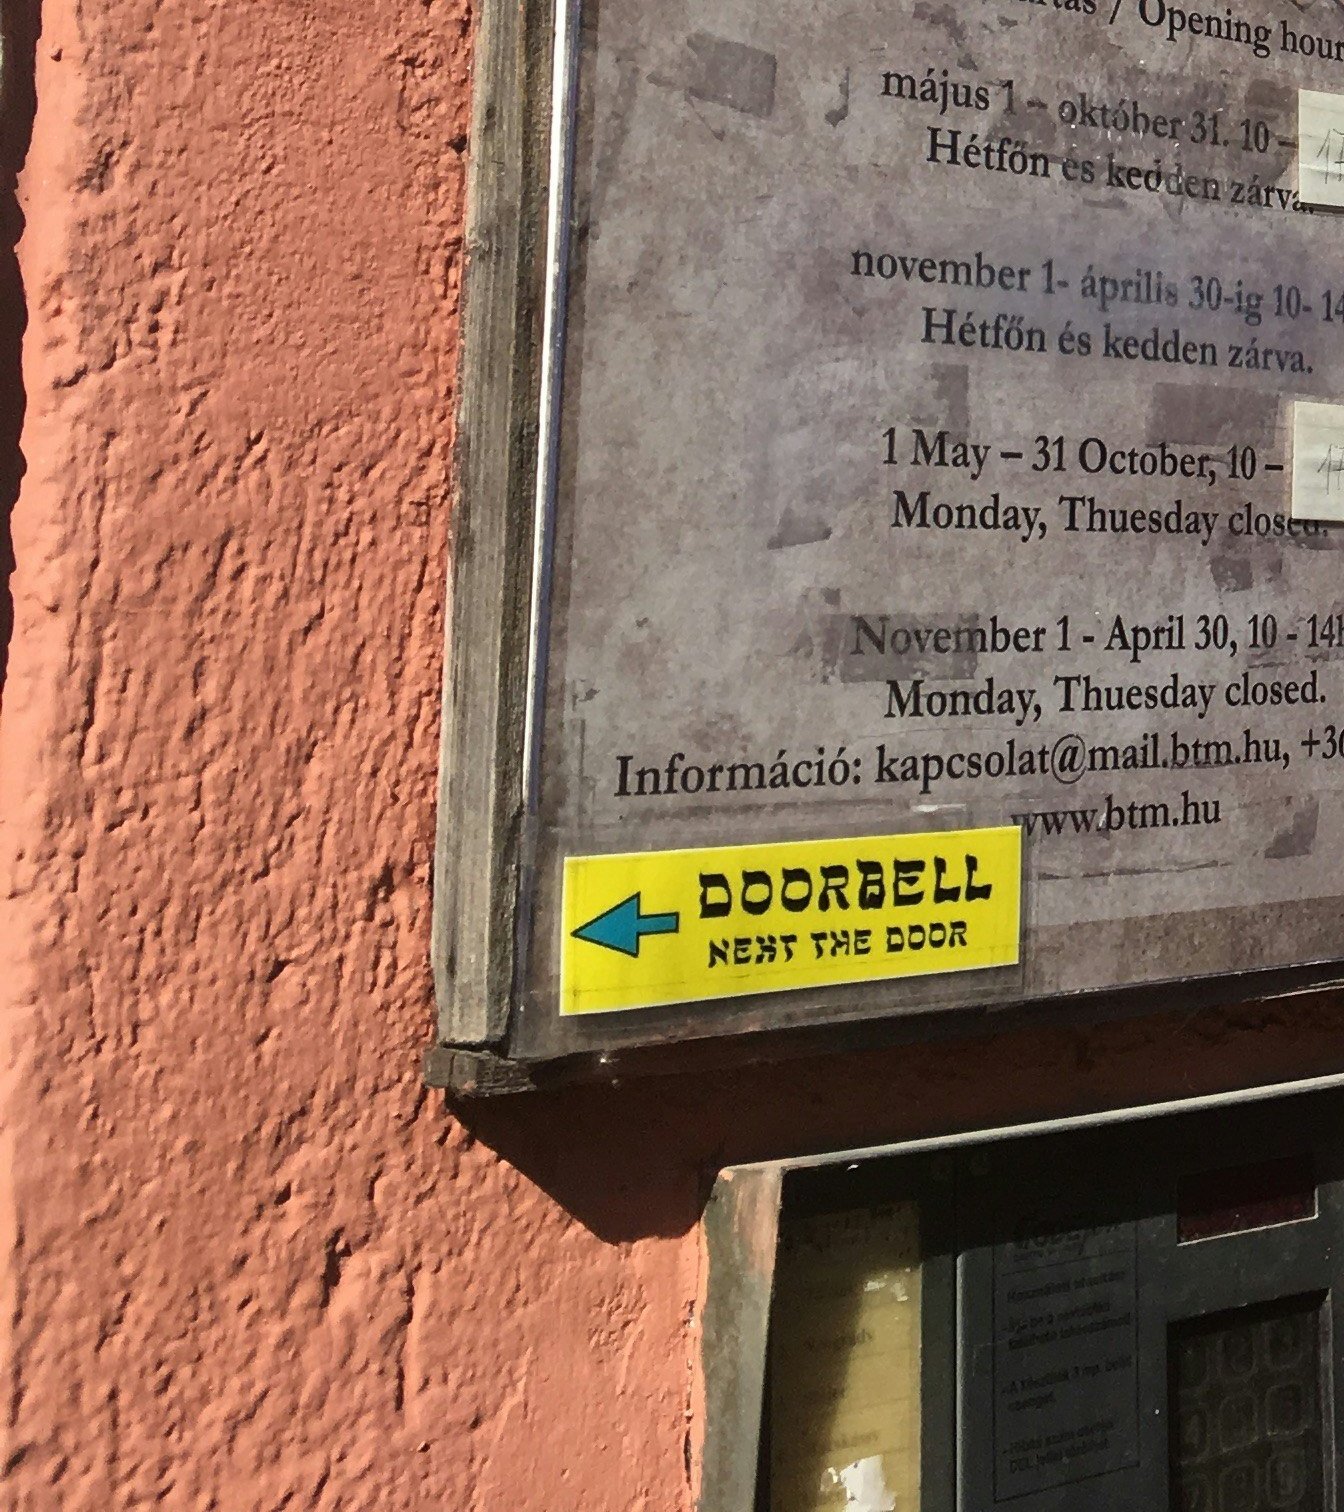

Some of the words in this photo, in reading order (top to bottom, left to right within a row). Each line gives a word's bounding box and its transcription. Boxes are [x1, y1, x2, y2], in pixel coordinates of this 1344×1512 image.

[881, 68, 990, 114] május
[1001, 80, 1016, 115] 1
[1058, 90, 1183, 141] október
[1190, 111, 1229, 147] 31.
[1241, 120, 1269, 153] 10
[926, 125, 1050, 178] Hétfőn
[1106, 153, 1221, 201] kedden
[851, 247, 1030, 293] november
[1080, 264, 1178, 312] április
[1188, 278, 1264, 327] 30-ig
[921, 306, 1046, 353] Hétfőn
[1058, 321, 1092, 356] és
[1103, 323, 1218, 367] kedden
[1228, 334, 1314, 375] zárva.
[882, 427, 898, 466] 1
[911, 429, 992, 481] May
[1032, 435, 1068, 473] 31
[1078, 436, 1217, 486] October,
[1227, 444, 1256, 480] 10
[891, 490, 1049, 542] Monday,
[1058, 494, 1219, 545] Thuesday
[850, 615, 1047, 657] November
[1056, 616, 1071, 651] 1
[1104, 614, 1186, 663] April
[1194, 616, 1238, 656] 30,
[1248, 614, 1277, 648] 10
[883, 678, 1043, 724] Monday,
[1053, 675, 1216, 720] Thuesday
[1225, 672, 1327, 707] closed.
[613, 745, 863, 798] Információ:
[874, 724, 1290, 793] kapcsolat@mail.btm.hu,
[1011, 791, 1222, 838] www.btm.hu
[699, 853, 993, 920] DOORBELL
[708, 930, 798, 968] NEXT
[810, 926, 872, 960] THE
[886, 920, 969, 954] DOOR
